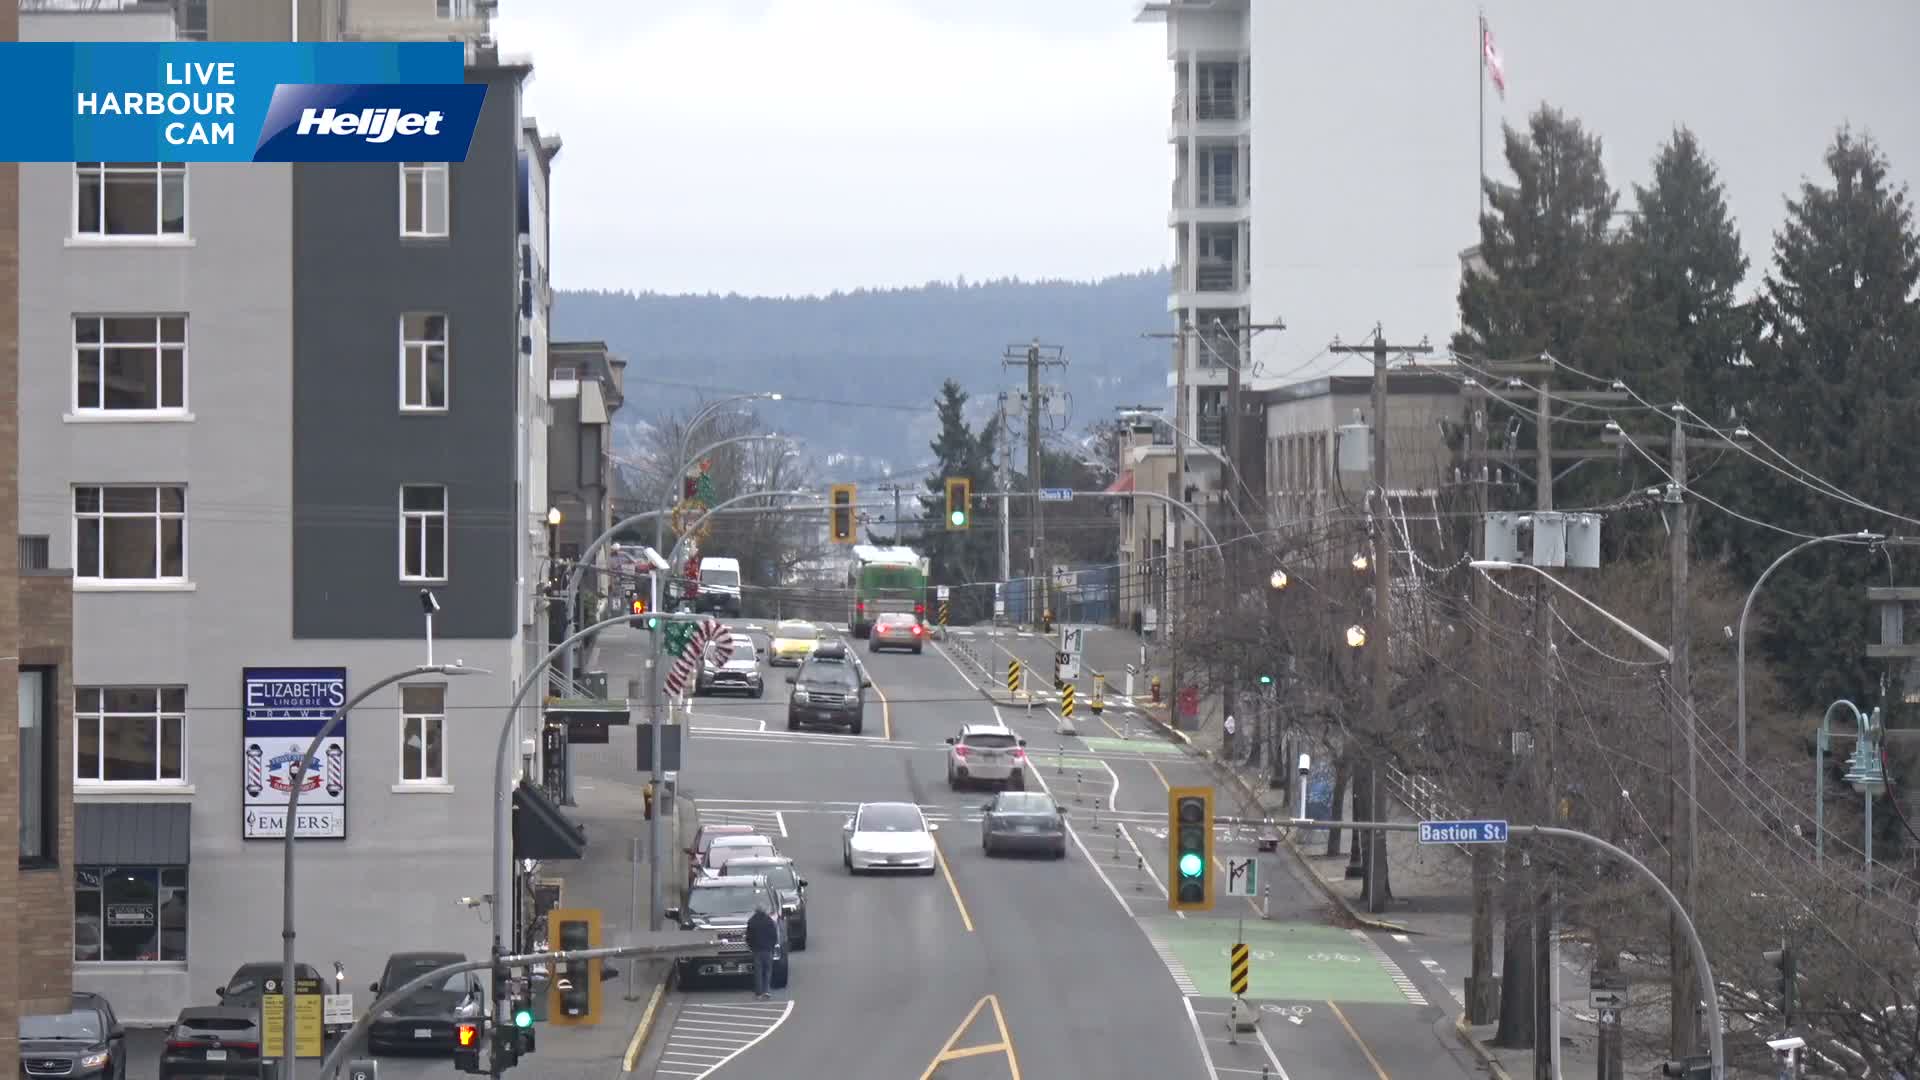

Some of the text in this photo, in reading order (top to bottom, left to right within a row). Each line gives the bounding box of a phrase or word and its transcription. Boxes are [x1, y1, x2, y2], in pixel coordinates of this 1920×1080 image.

[247, 682, 344, 707] ELIZABETH'S
[273, 698, 321, 706] LINGERIE
[259, 815, 329, 829] EMERS
[1421, 823, 1505, 841] Bastion St.
